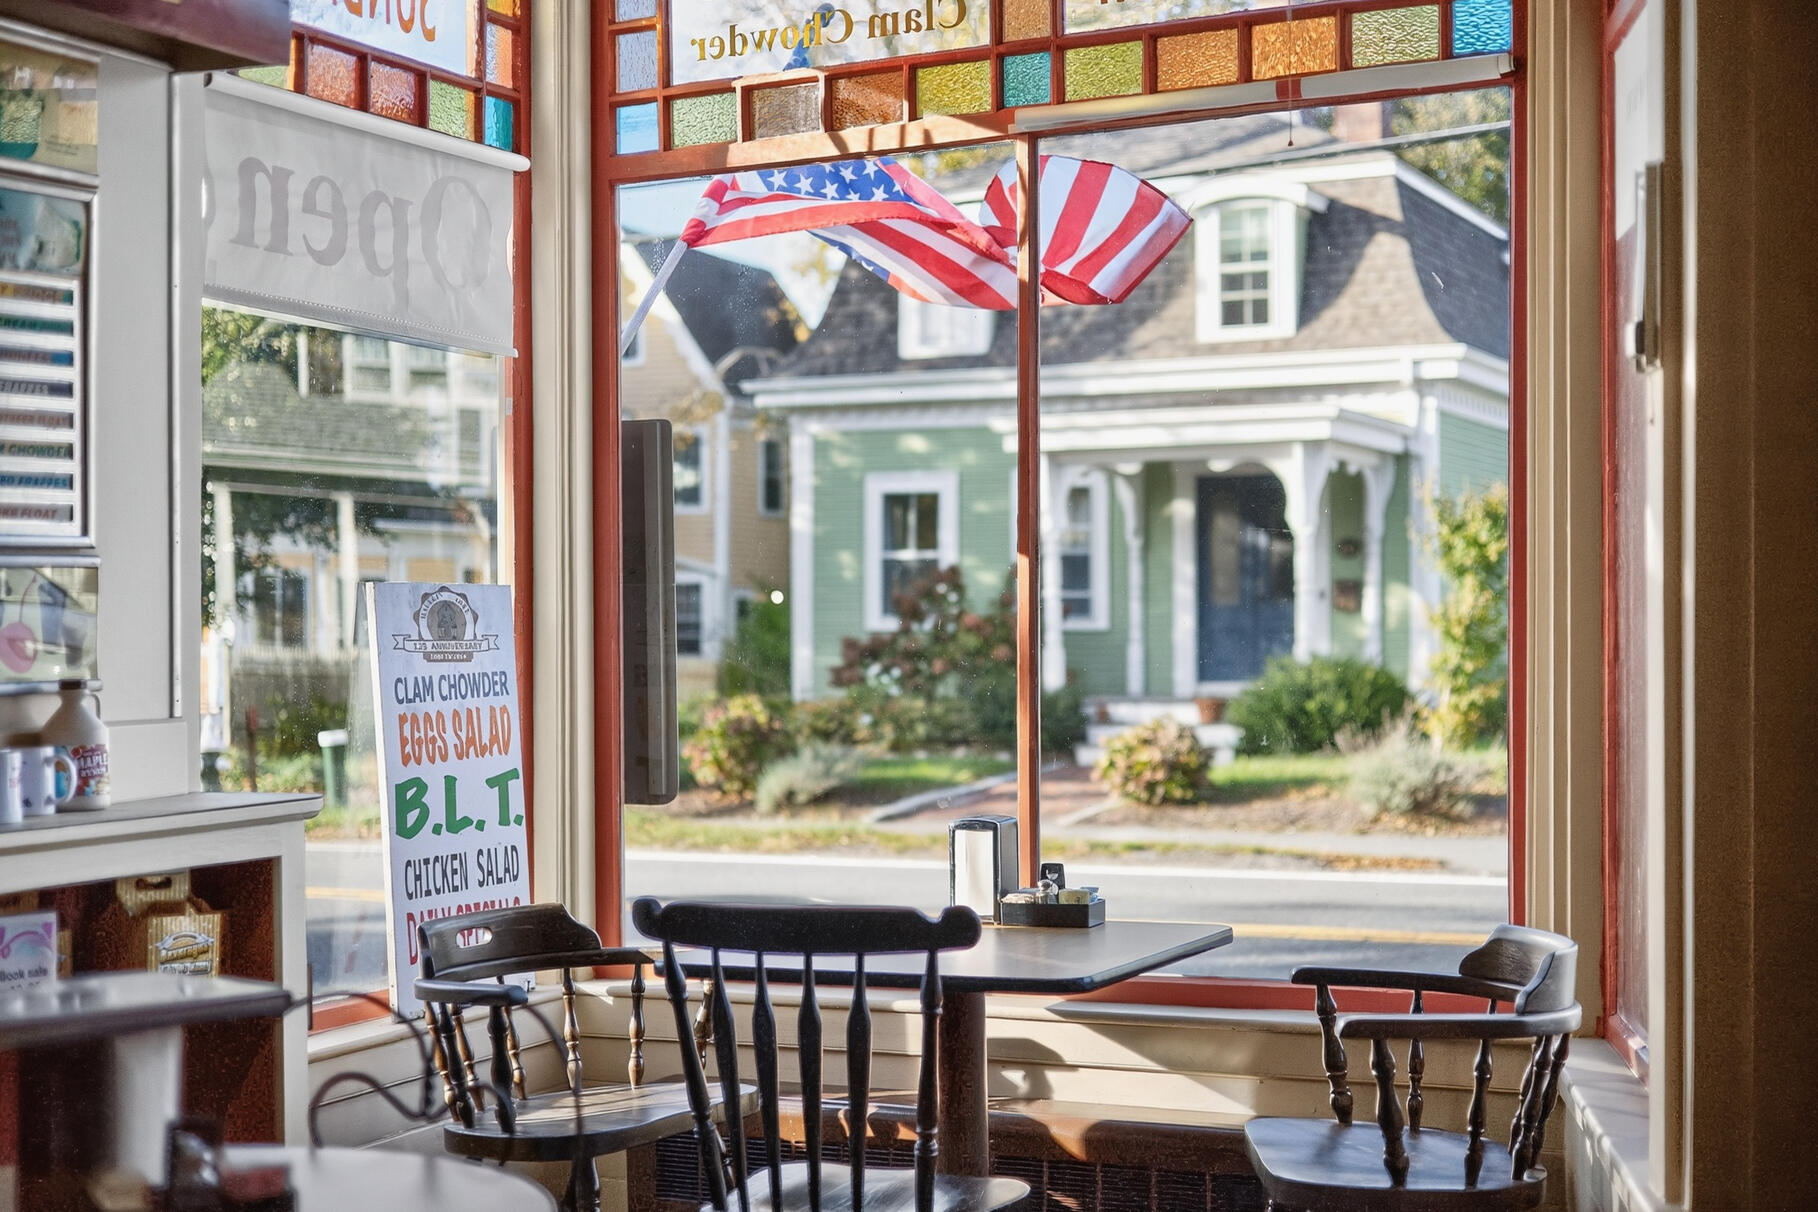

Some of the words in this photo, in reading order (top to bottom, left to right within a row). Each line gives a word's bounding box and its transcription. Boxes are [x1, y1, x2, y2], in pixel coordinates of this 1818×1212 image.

[394, 675, 435, 705] CLAM
[438, 670, 510, 701] CHOWDER
[398, 709, 449, 768] EGGS
[452, 704, 511, 761] SALAD
[395, 767, 524, 840] B.L.T.
[404, 851, 469, 900] CHICKEN
[476, 844, 520, 888] SALAD
